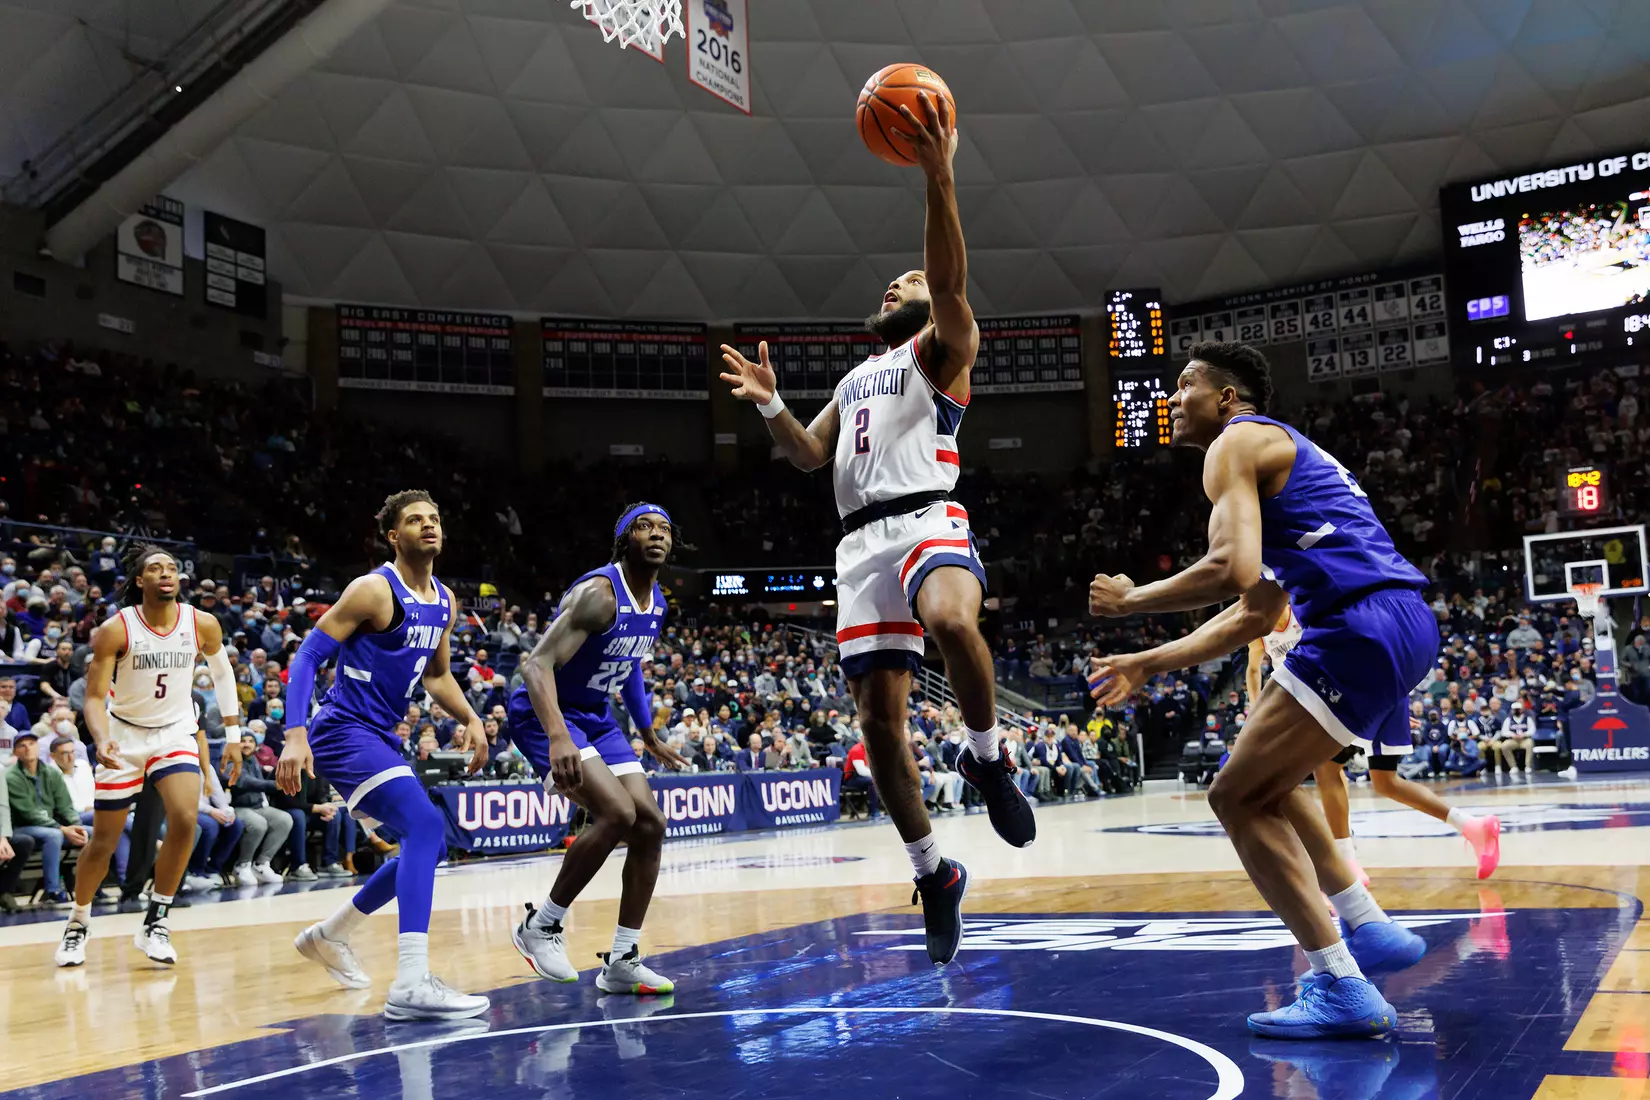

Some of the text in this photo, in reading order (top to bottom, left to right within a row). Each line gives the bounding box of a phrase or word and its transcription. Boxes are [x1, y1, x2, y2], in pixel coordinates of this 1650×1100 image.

[696, 29, 743, 75] 2016
[698, 58, 741, 91] NATIONAL
[695, 71, 744, 107] CHAMPIONS
[1471, 162, 1595, 202] UNIVERSITY
[1598, 156, 1628, 177] OF
[1456, 218, 1505, 236] WELLS
[1460, 230, 1505, 248] FARGO
[1415, 293, 1441, 311] 42
[340, 307, 509, 328] BIG EAST CONFERENCE
[978, 316, 1072, 331] HAMPIONSHIP
[1308, 311, 1333, 329] 42
[1343, 306, 1368, 323] 44
[1240, 324, 1264, 342] 22
[1273, 318, 1299, 335] 25
[1350, 351, 1369, 367] 13
[1383, 344, 1407, 361] 22
[1311, 355, 1337, 373] 24
[839, 368, 907, 413] ONNECTICUT
[855, 407, 871, 455] 2
[1577, 486, 1599, 510] 18
[602, 635, 637, 657] SETON
[132, 651, 194, 671] CONNECTICUT
[586, 660, 634, 693] 22
[155, 673, 169, 700] 5
[1571, 746, 1650, 762] TRAVELERS
[652, 784, 735, 821] UCONN
[761, 778, 834, 813] UCONN
[457, 790, 571, 831] UCONN
[775, 812, 825, 826] BASKETBALL
[665, 822, 722, 839] BASKETBALL
[473, 833, 553, 848] BASKETBALL
